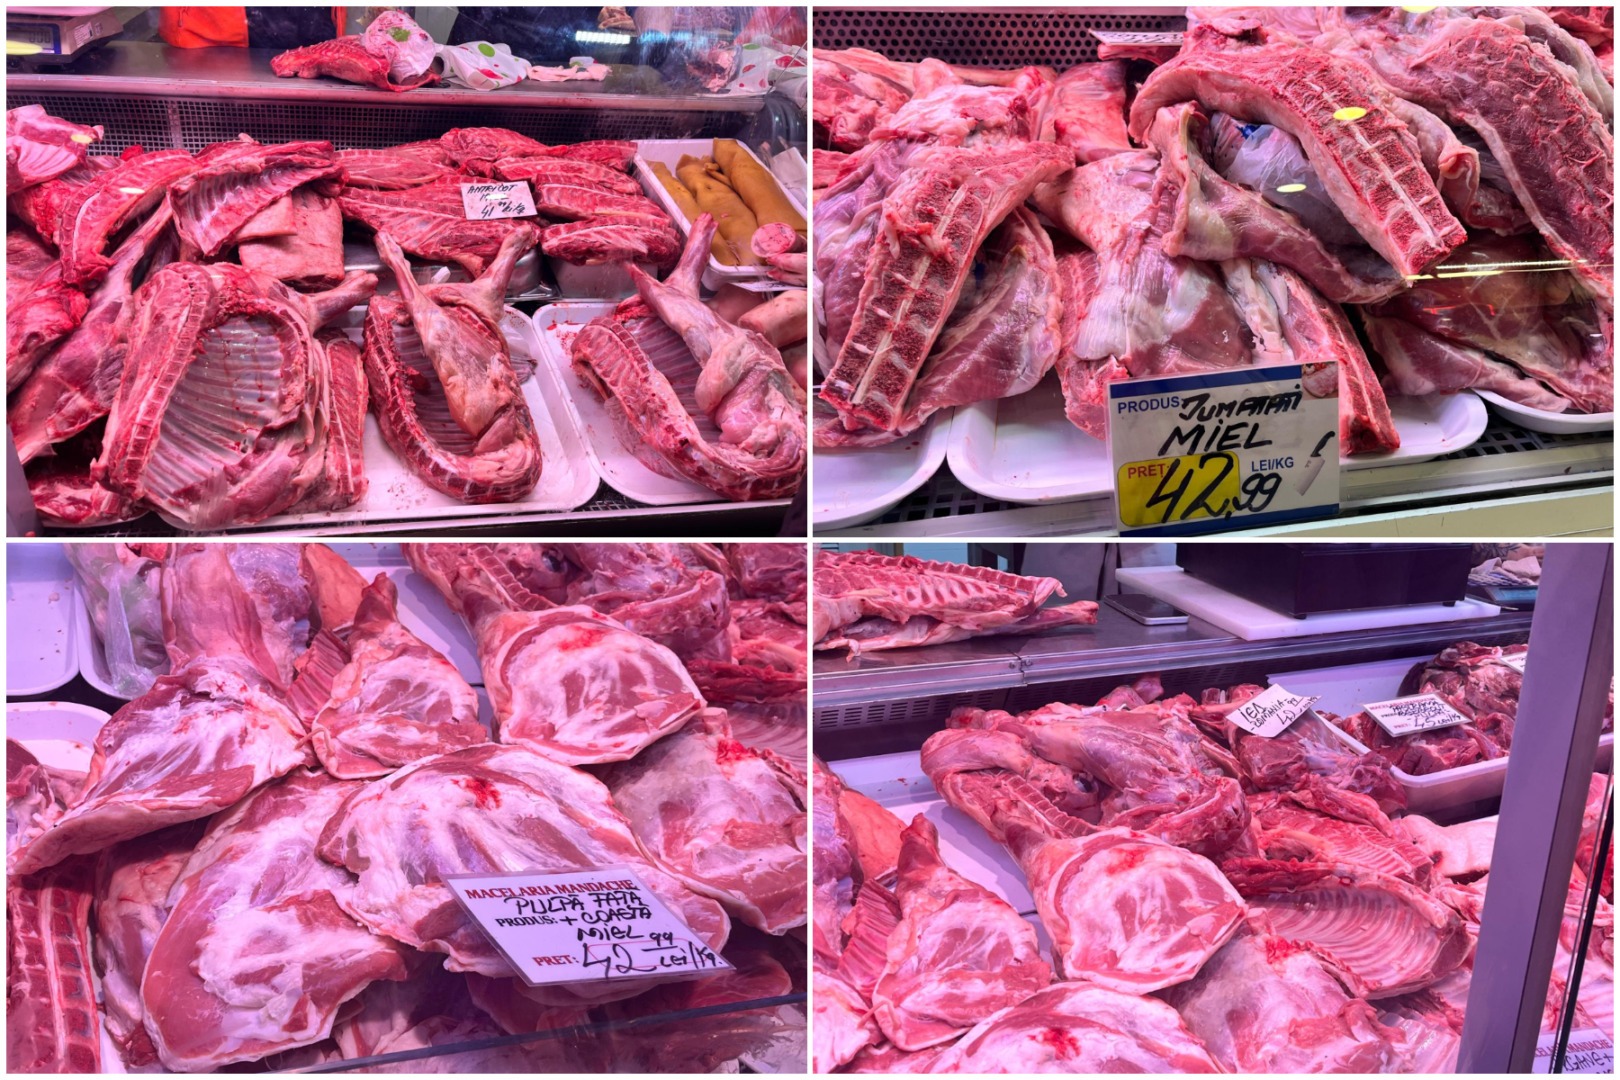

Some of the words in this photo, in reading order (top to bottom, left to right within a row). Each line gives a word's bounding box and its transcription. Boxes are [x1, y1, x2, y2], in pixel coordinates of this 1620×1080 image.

[1251, 456, 1294, 473] LEI/KG
[464, 884, 557, 899] MACELARIA
[555, 879, 640, 895] MANDACHE
[494, 915, 558, 927] PRODUS:
[559, 915, 578, 926] +
[532, 954, 580, 967] PRET:
[582, 942, 657, 979] 42
[649, 931, 674, 947] 99
